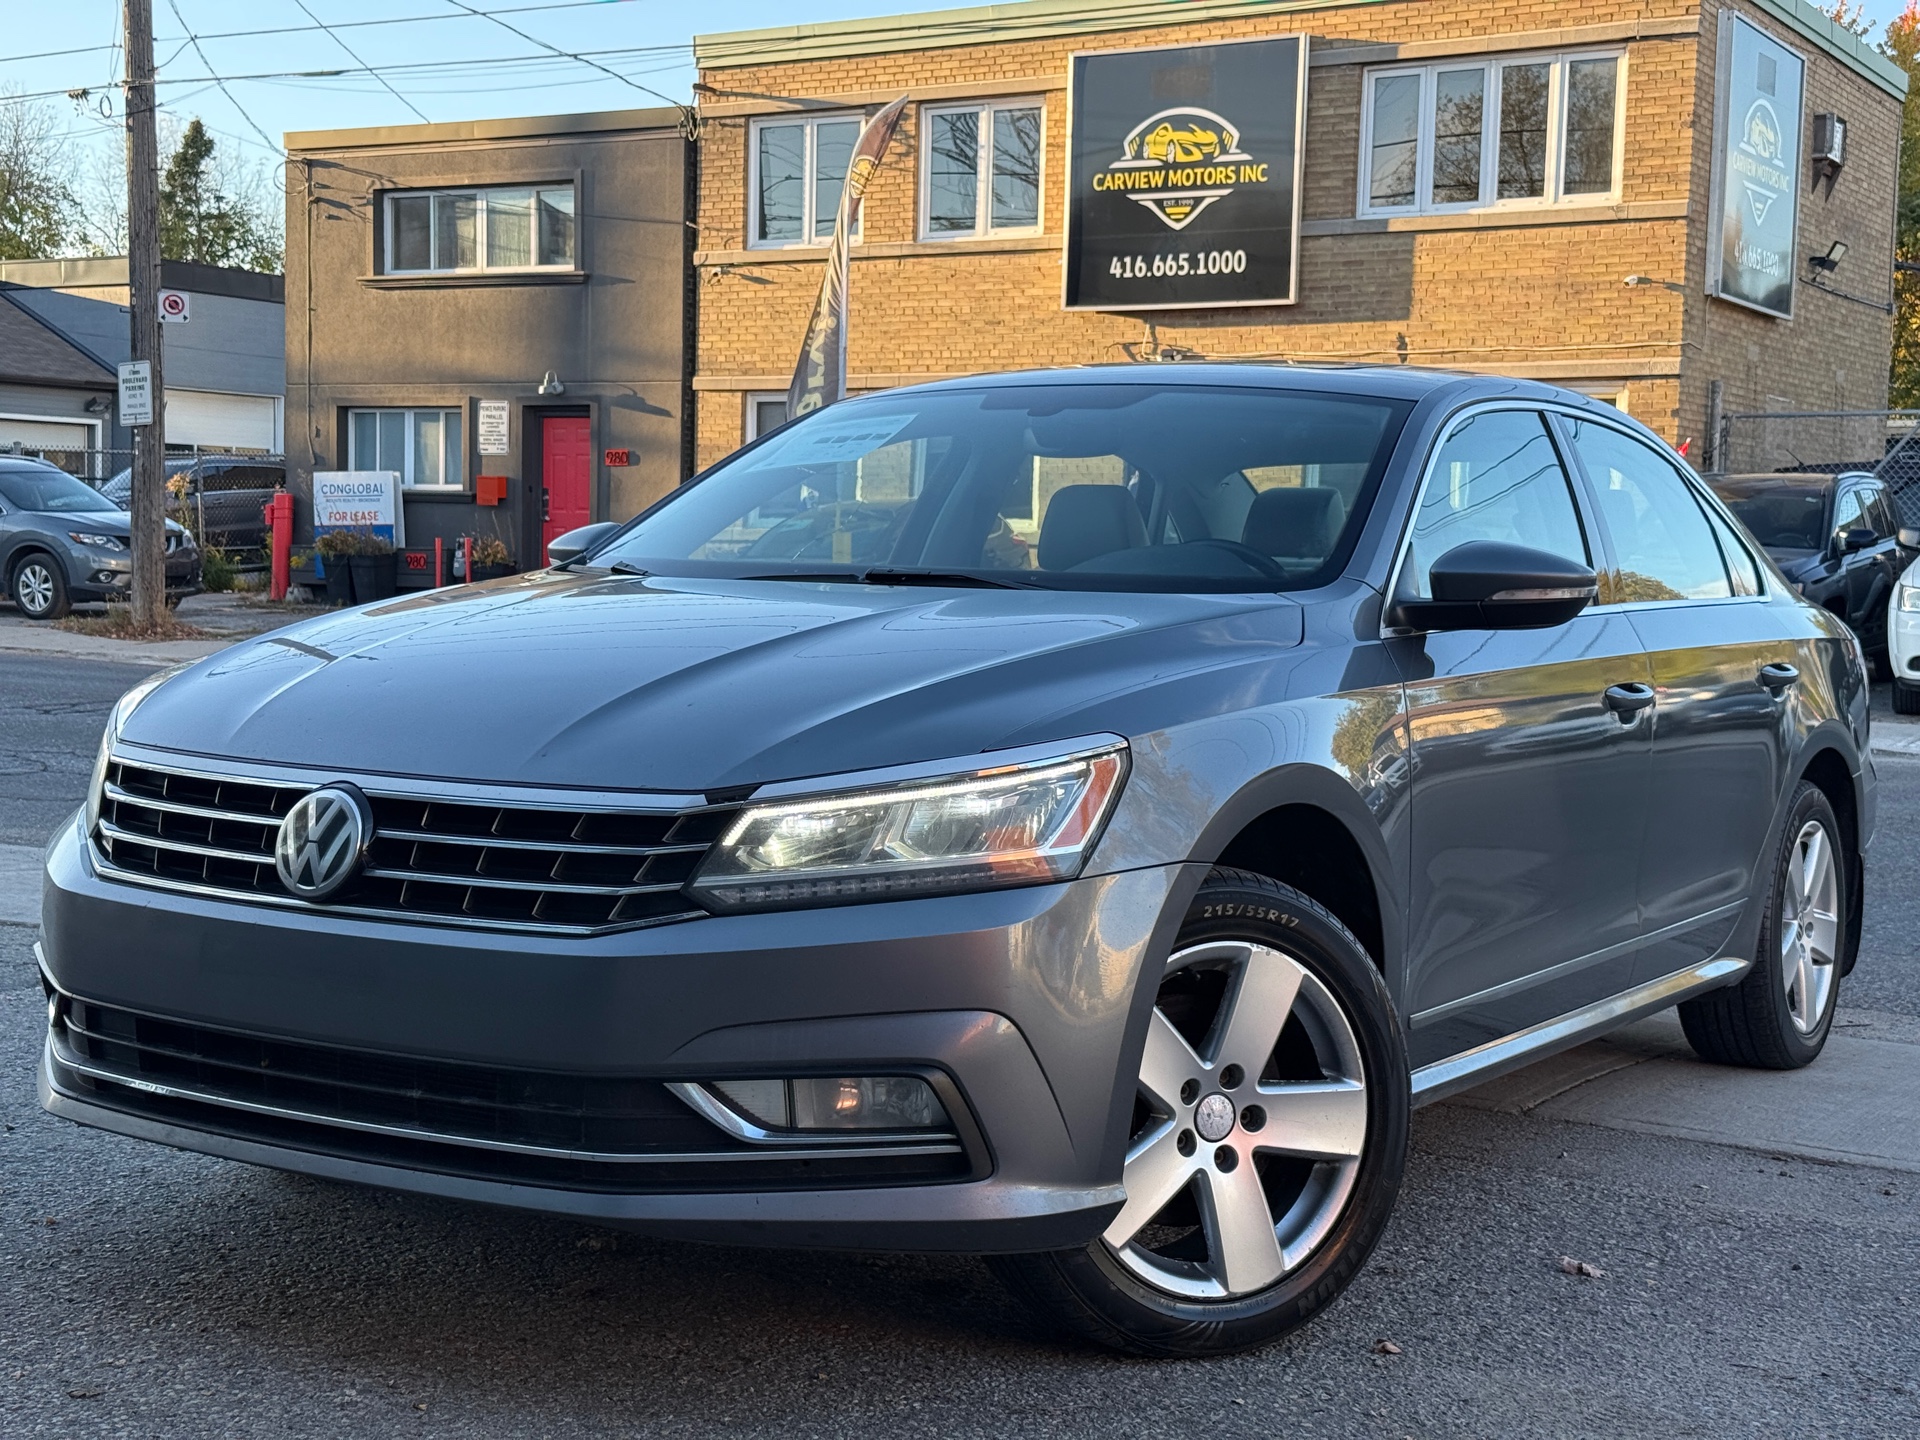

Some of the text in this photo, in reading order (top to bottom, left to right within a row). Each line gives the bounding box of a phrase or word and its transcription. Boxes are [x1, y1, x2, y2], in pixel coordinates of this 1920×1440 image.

[1093, 163, 1269, 191] CARVIEW MOTORS INC
[1733, 151, 1790, 193] CARVIEW MOTORS INC
[1109, 249, 1247, 279] 416.665.1000
[122, 376, 148, 385] BOULEVARD
[125, 384, 145, 392] PARKING
[606, 451, 629, 465] 980
[321, 483, 385, 495] CDNGLOBAL
[328, 511, 379, 522] FOR LEASE
[406, 555, 427, 568] 980
[275, 788, 362, 897] VW
[1203, 903, 1300, 928] 215/55R17
